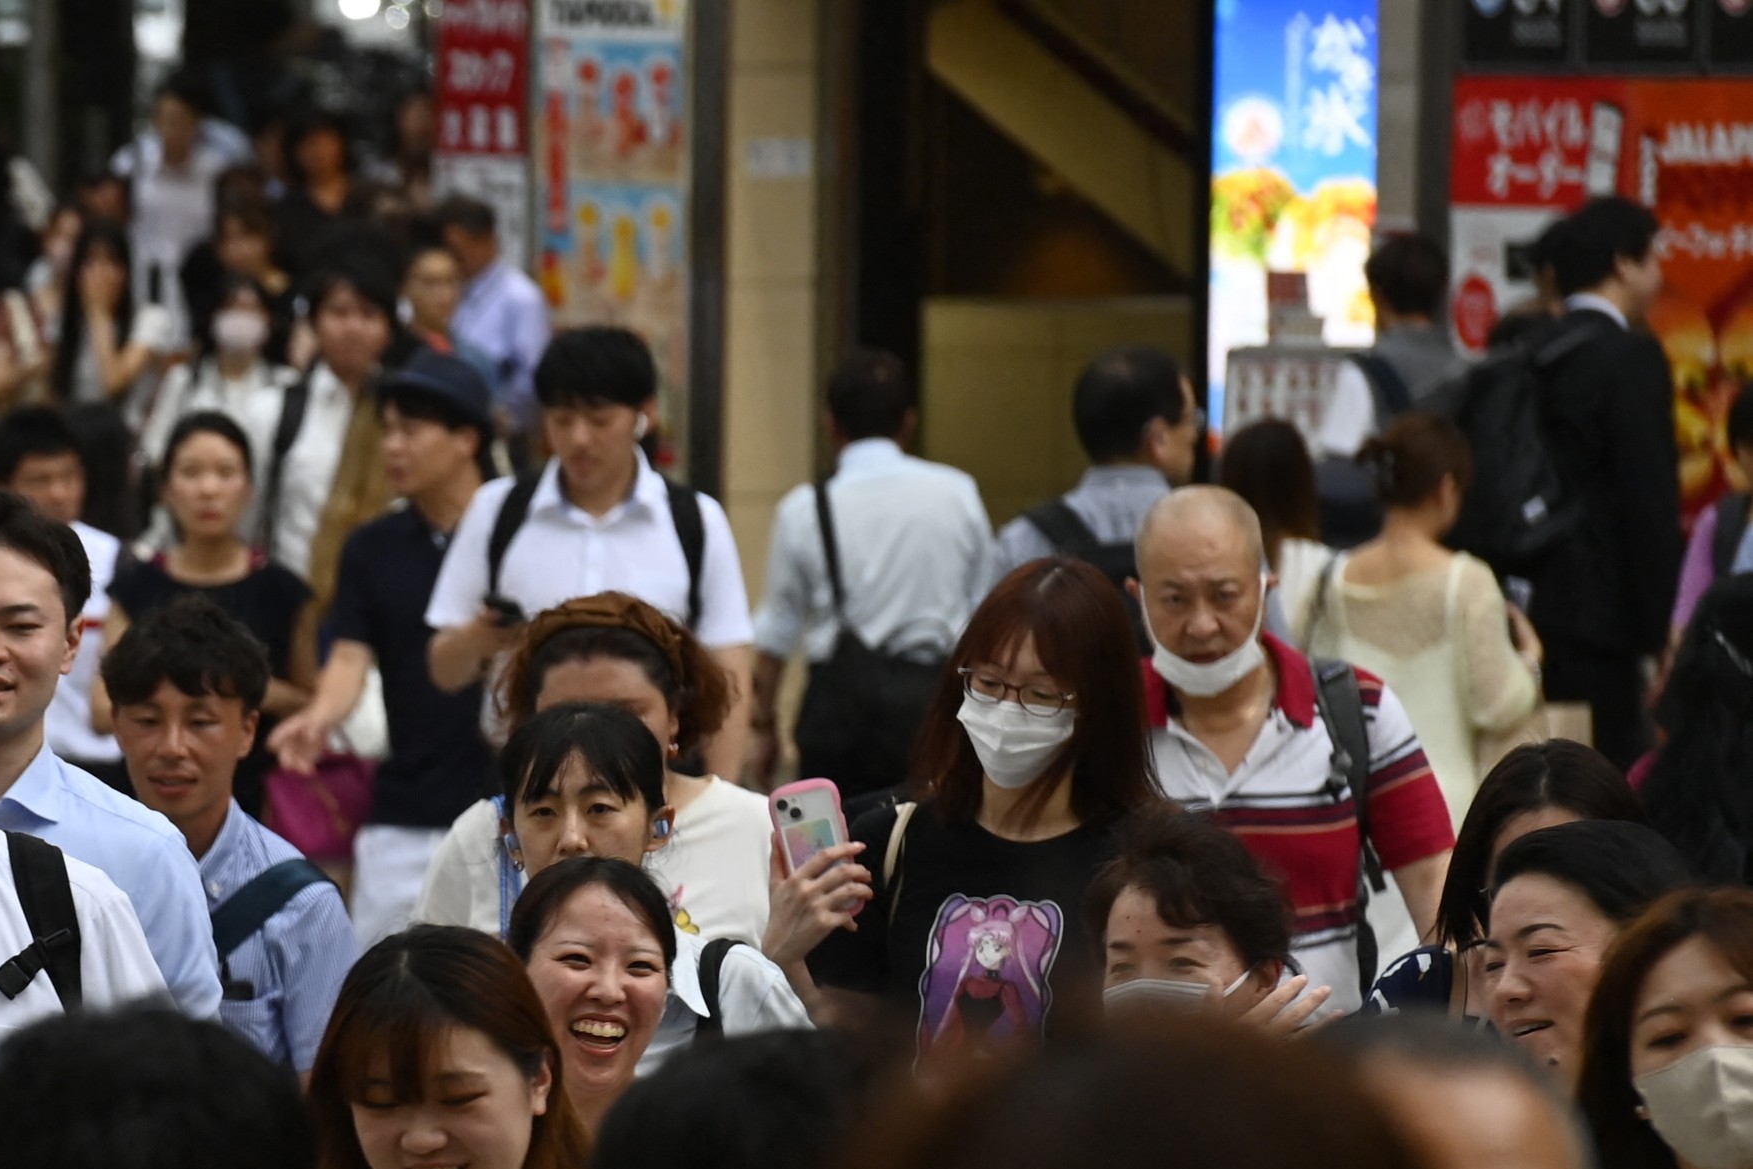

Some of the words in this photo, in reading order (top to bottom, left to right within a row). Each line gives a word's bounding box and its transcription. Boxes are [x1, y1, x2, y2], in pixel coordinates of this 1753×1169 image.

[1490, 98, 1587, 150] モバイル
[1487, 152, 1590, 199] オーダー
